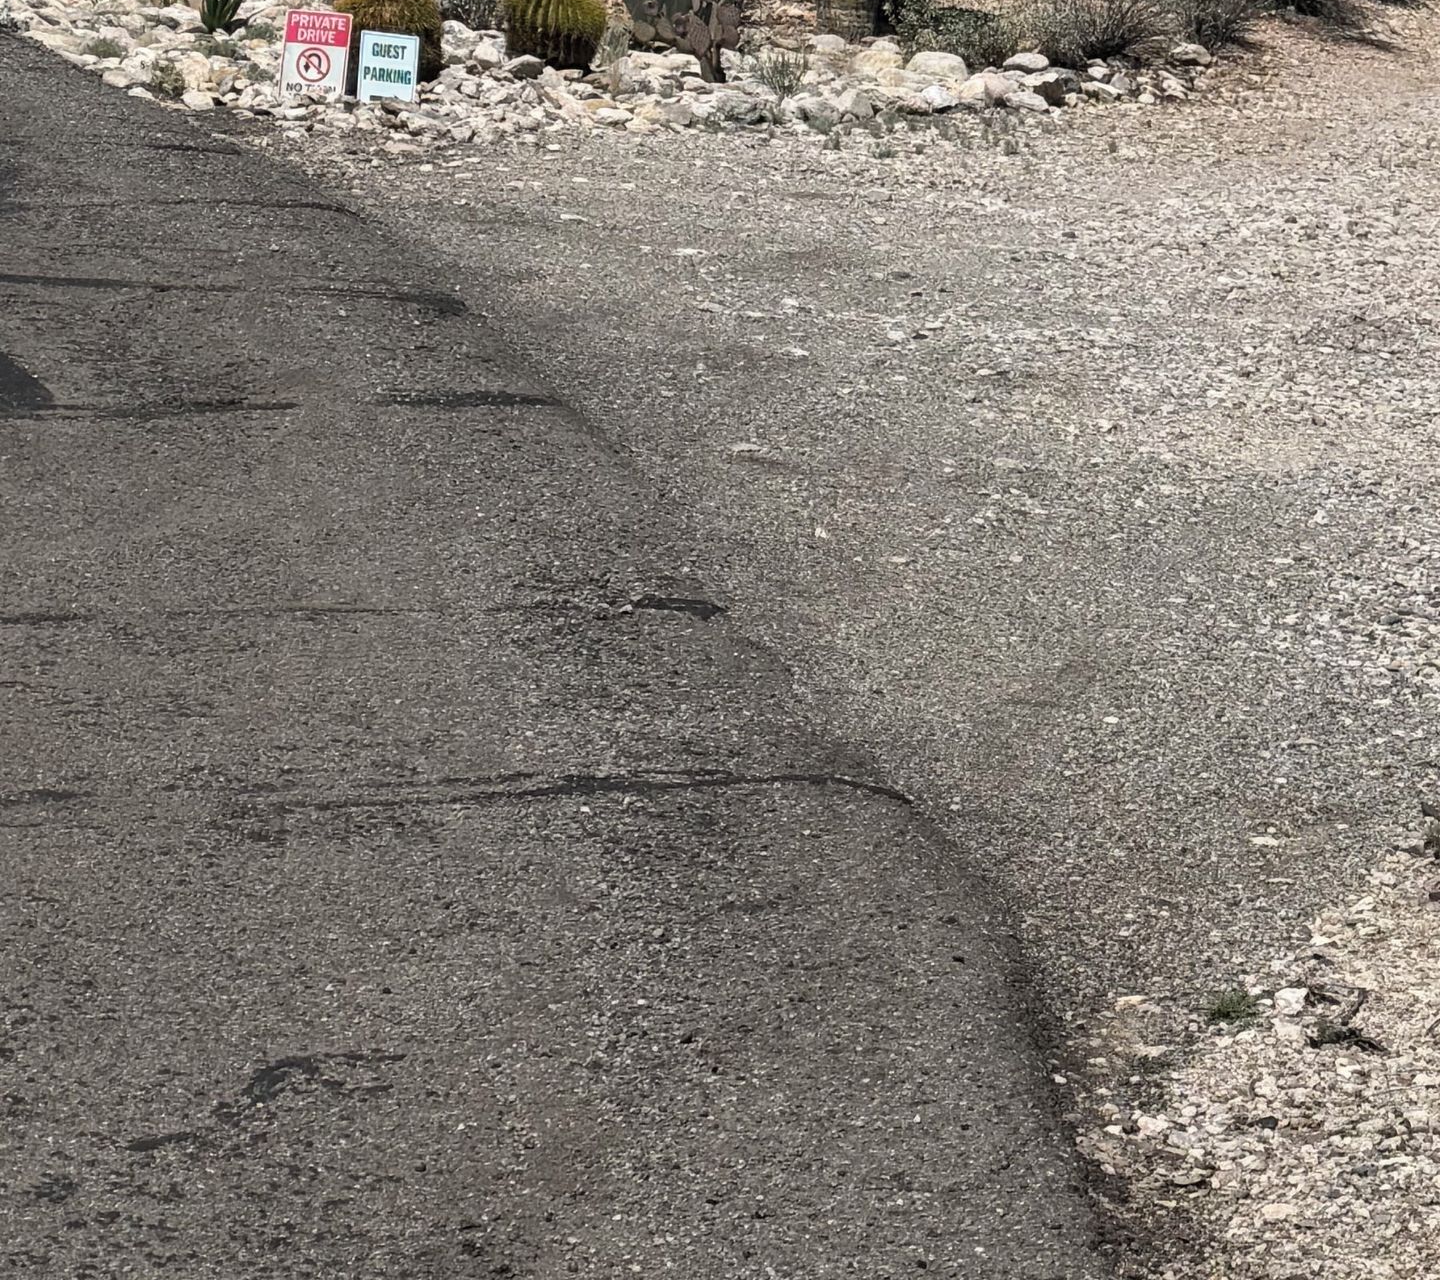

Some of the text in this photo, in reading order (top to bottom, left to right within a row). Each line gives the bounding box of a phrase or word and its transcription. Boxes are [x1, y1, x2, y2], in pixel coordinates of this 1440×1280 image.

[291, 14, 346, 30] PRIVATE
[297, 28, 336, 43] DRIVE
[372, 43, 407, 60] GUEST
[363, 66, 411, 85] PARKING
[286, 82, 302, 92] NO
